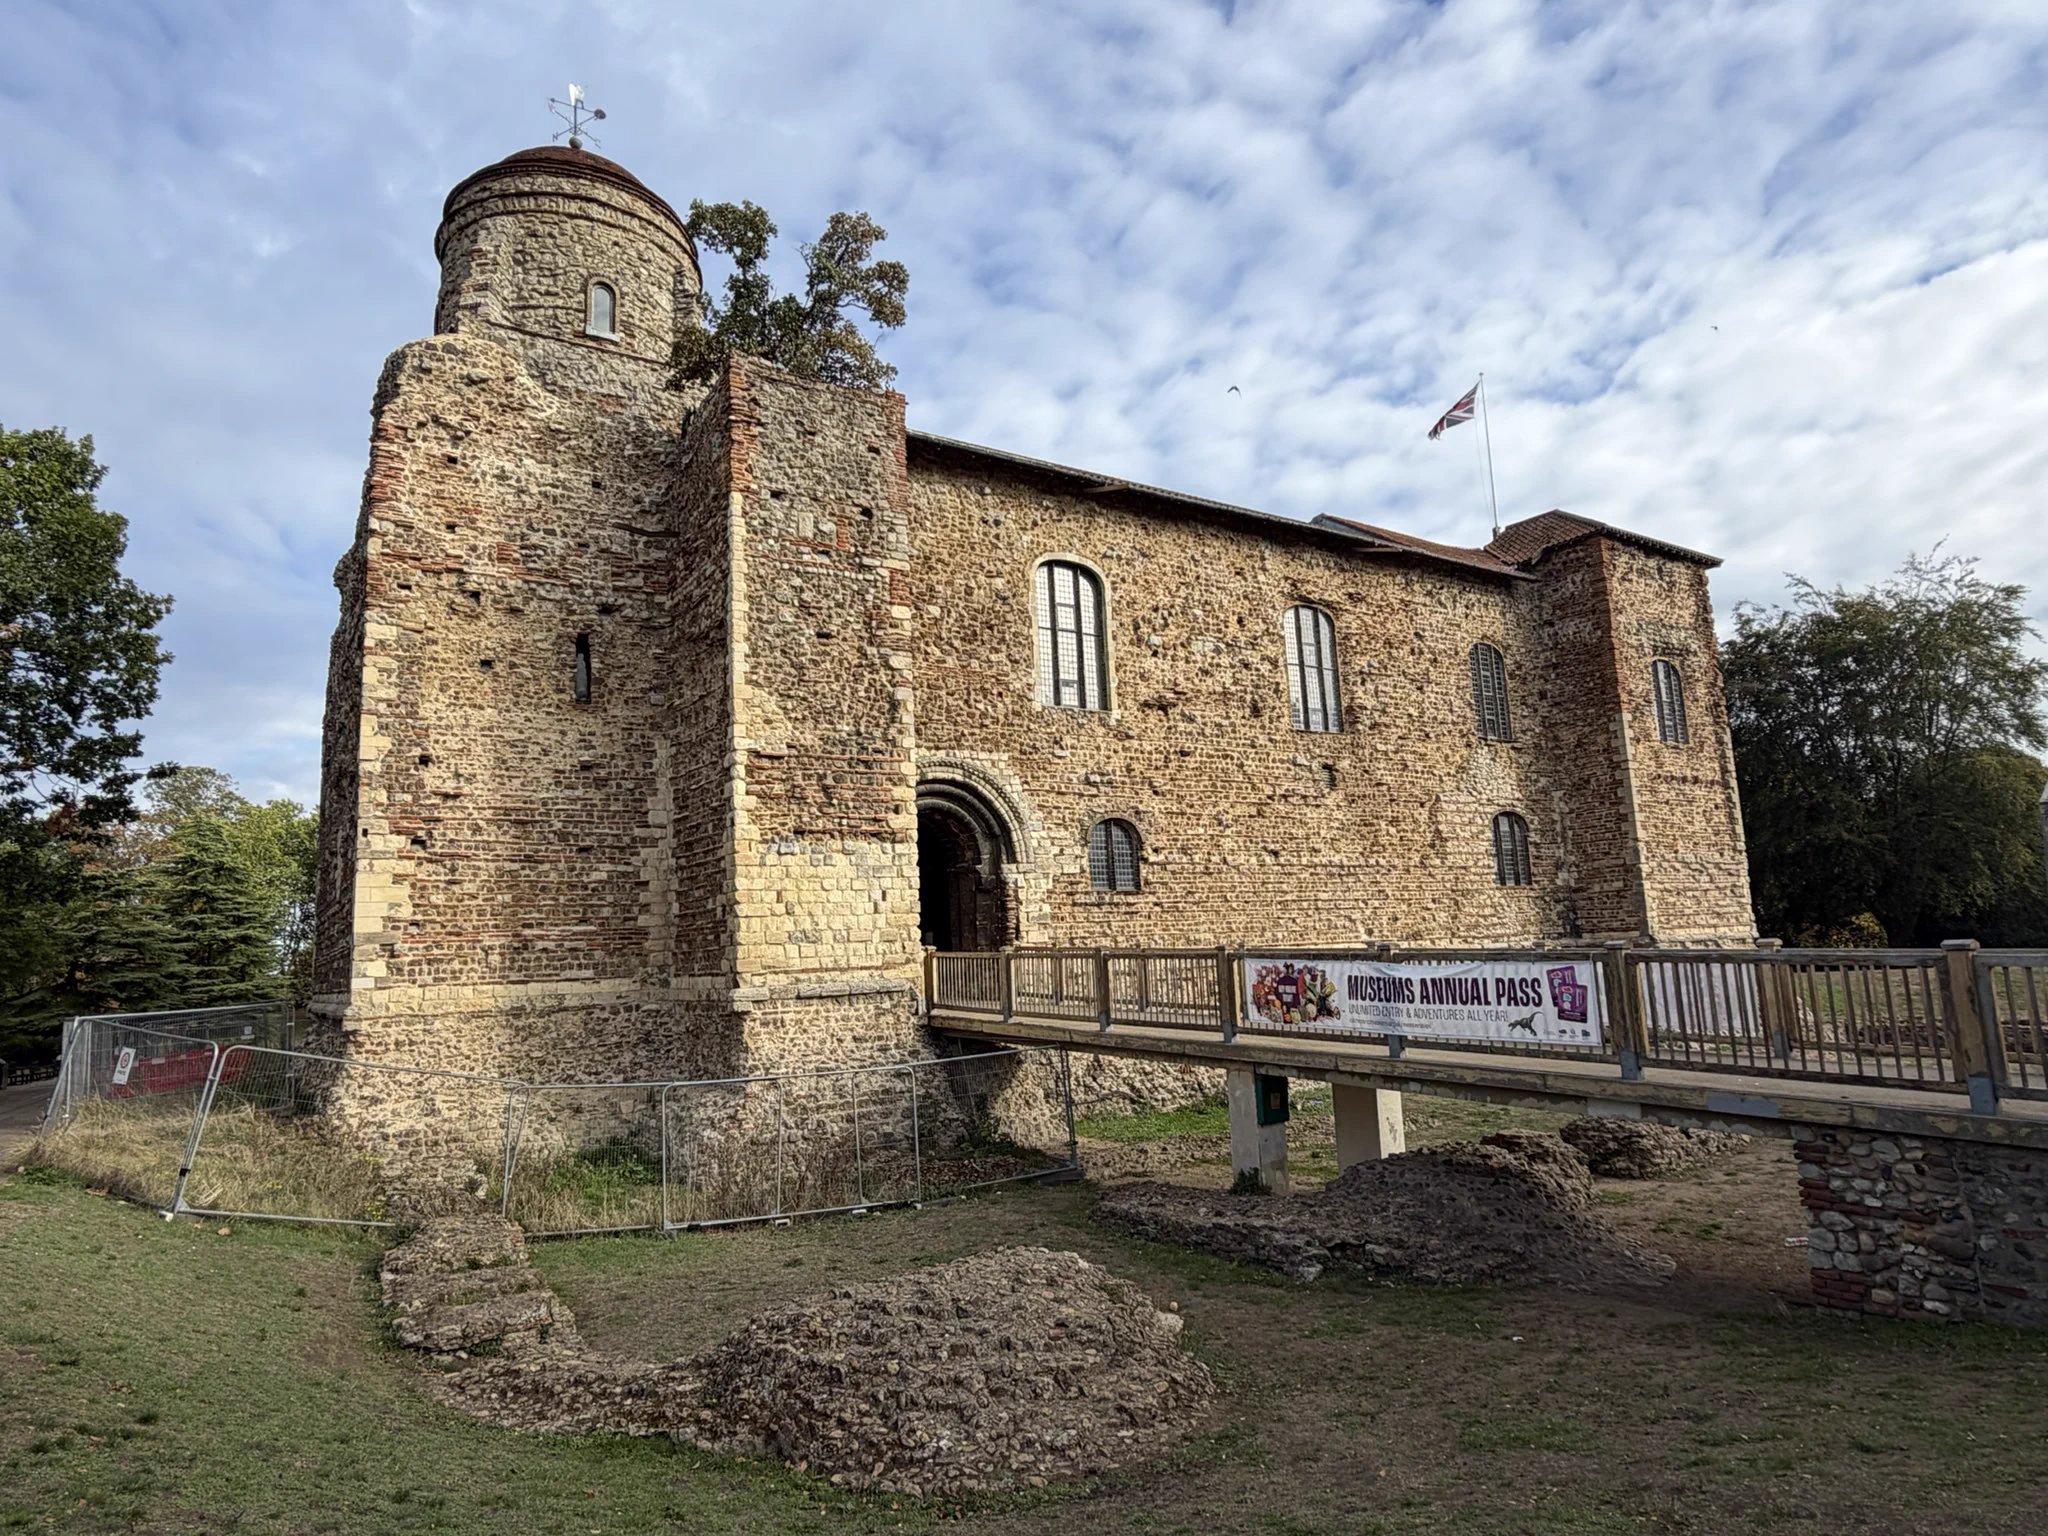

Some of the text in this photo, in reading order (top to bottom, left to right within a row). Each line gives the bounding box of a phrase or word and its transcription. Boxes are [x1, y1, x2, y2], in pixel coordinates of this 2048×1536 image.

[1348, 975, 1415, 1004] MUSEUMS
[1420, 977, 1491, 1006] ANNUAL
[1495, 977, 1543, 1007] PASS
[1349, 1003, 1508, 1022] UNLIMITED ENTRY & ADVENTURES ALL YEAR!
